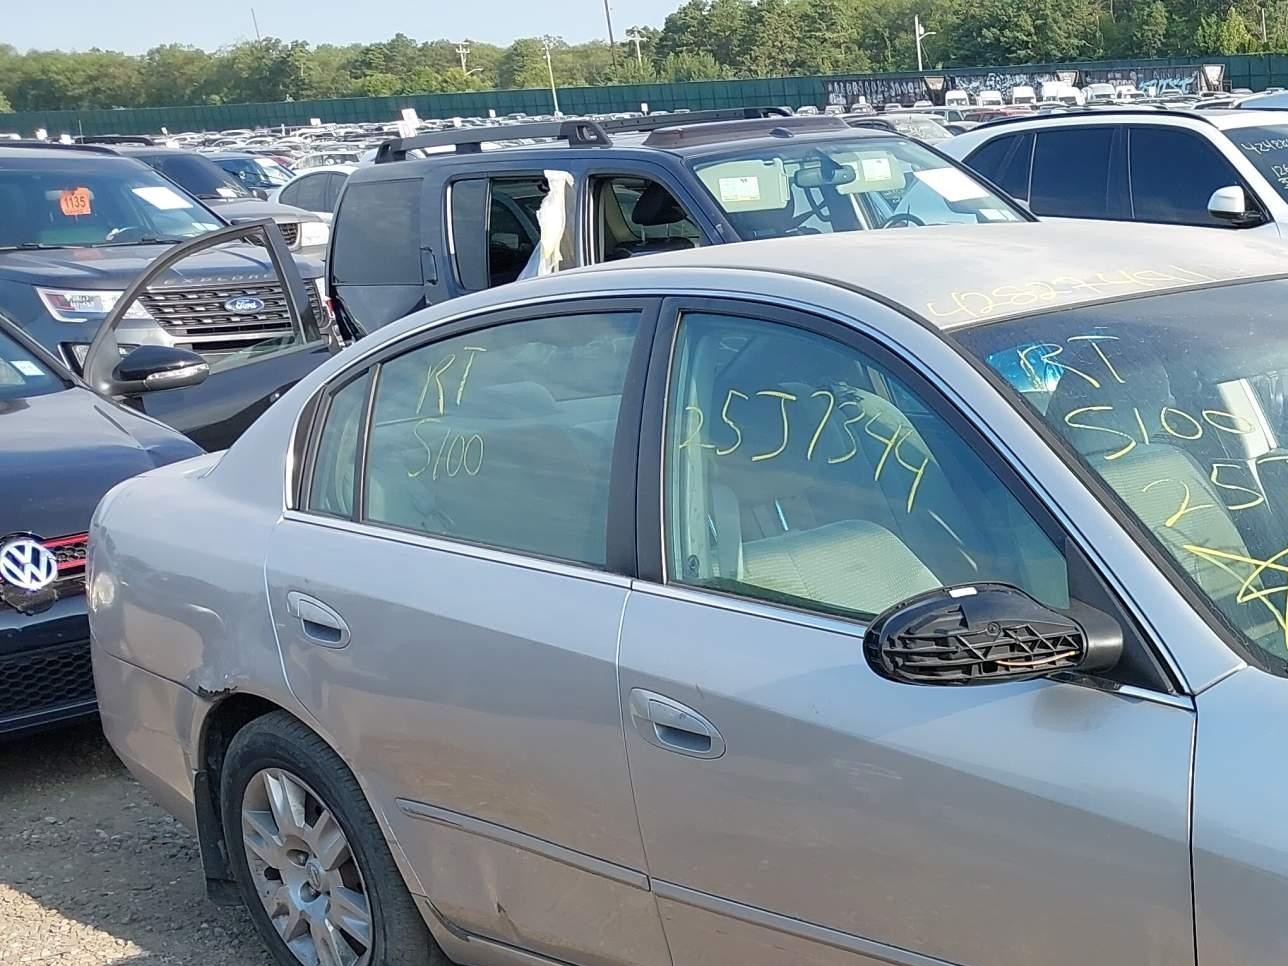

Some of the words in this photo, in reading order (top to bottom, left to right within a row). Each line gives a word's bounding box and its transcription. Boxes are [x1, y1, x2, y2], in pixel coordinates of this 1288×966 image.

[65, 196, 86, 208] 1135
[416, 347, 488, 415] RT
[1017, 336, 1126, 389] RT
